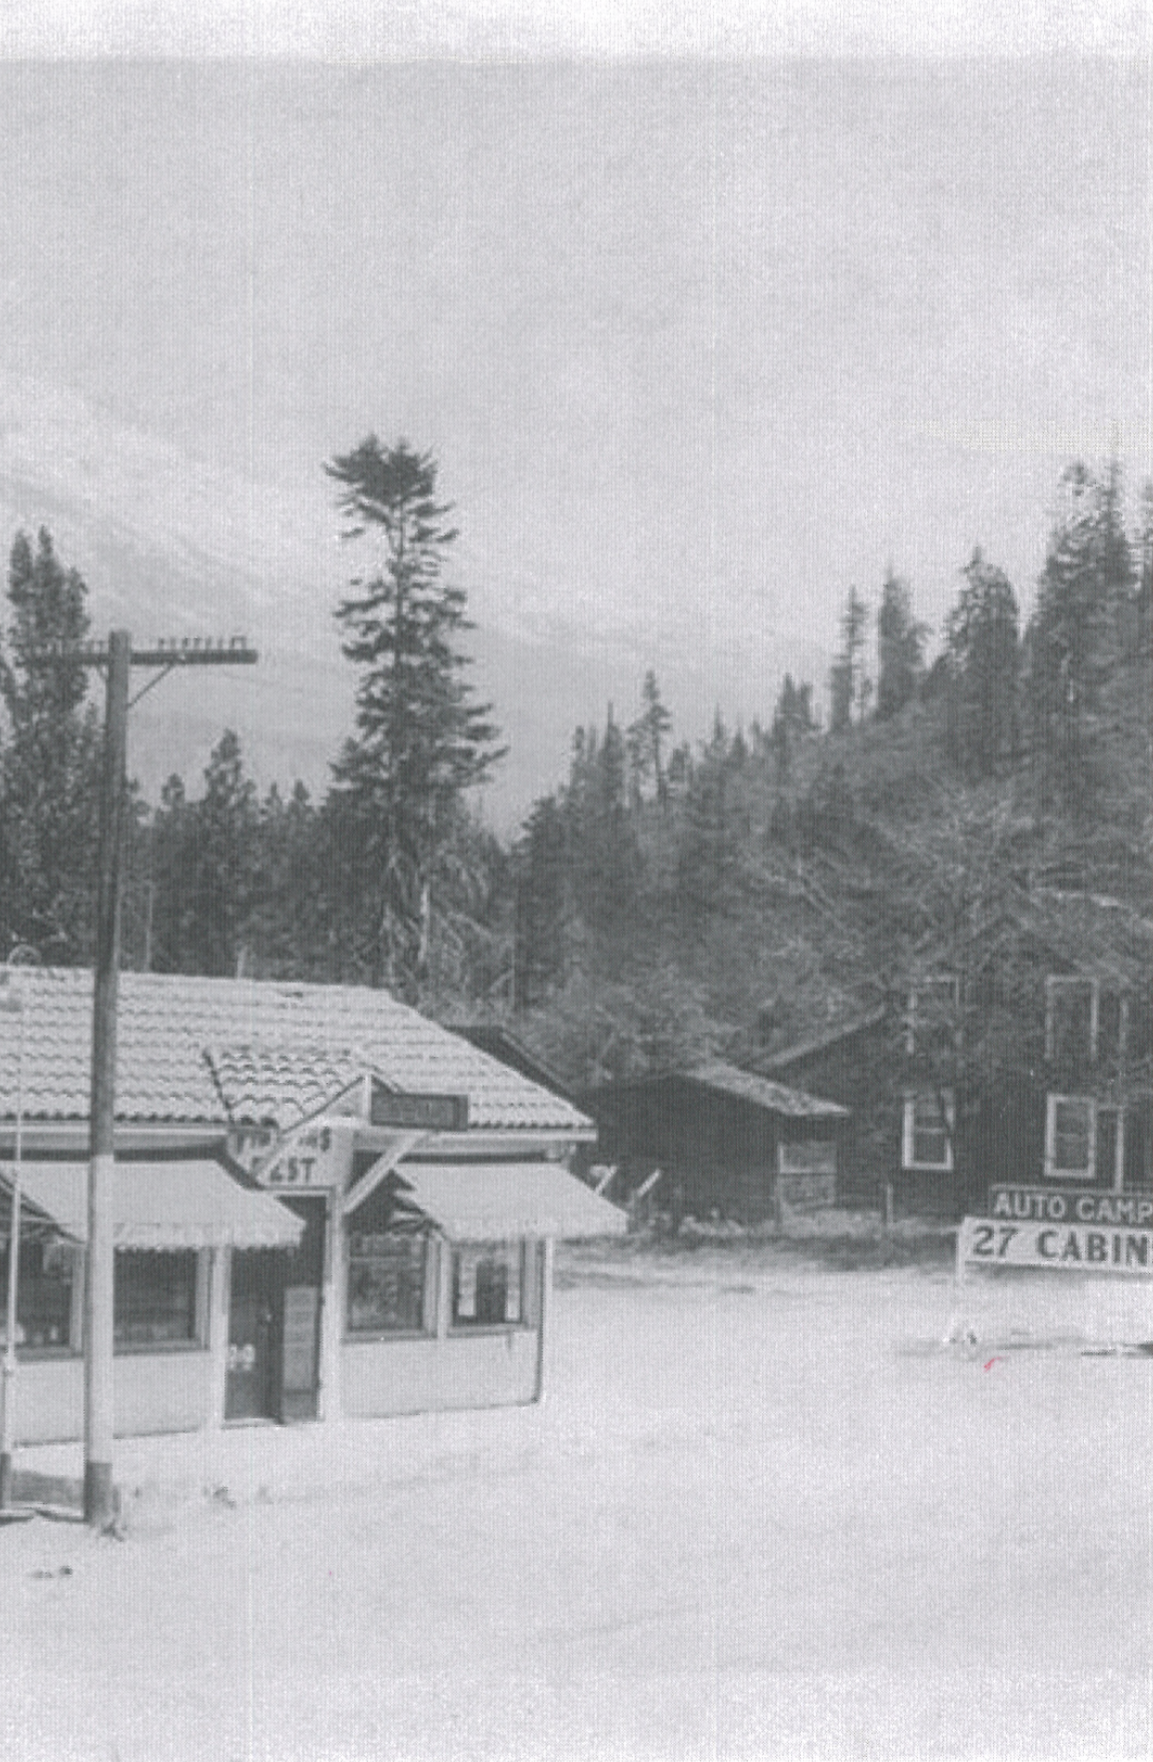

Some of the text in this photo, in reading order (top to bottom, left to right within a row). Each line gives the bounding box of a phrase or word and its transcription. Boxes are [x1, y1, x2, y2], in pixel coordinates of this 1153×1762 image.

[994, 1192, 1153, 1225] AUTO CAMP
[973, 1225, 1018, 1257] 27
